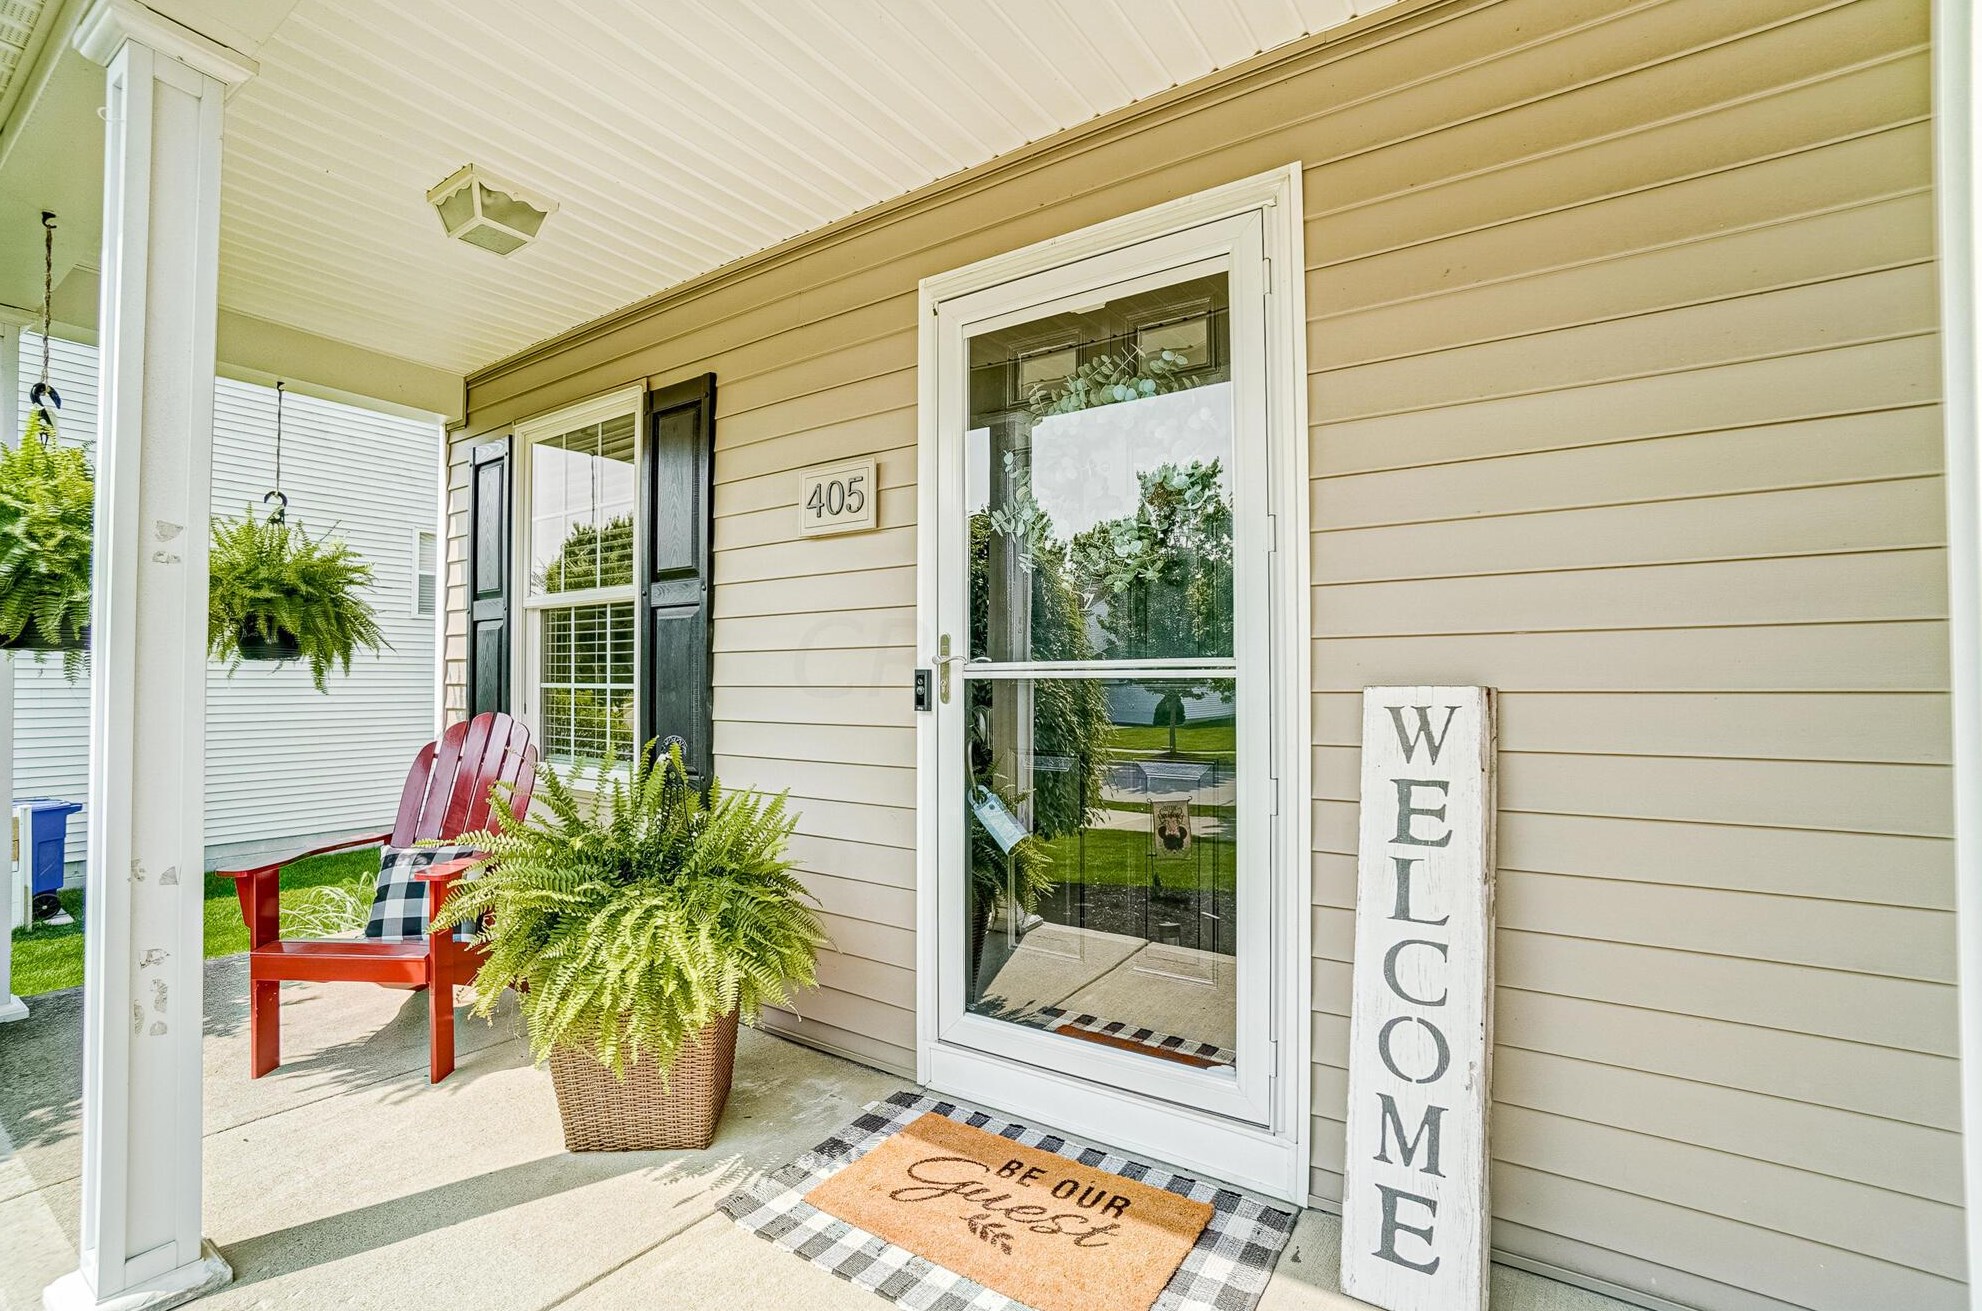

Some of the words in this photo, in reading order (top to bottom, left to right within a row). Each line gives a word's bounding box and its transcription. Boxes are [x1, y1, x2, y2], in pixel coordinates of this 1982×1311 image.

[806, 476, 865, 518] 405
[1371, 705, 1463, 1276] WELCOME
[889, 1156, 1121, 1248] Guest
[995, 1158, 1047, 1188] BE
[1051, 1180, 1131, 1219] OUR
